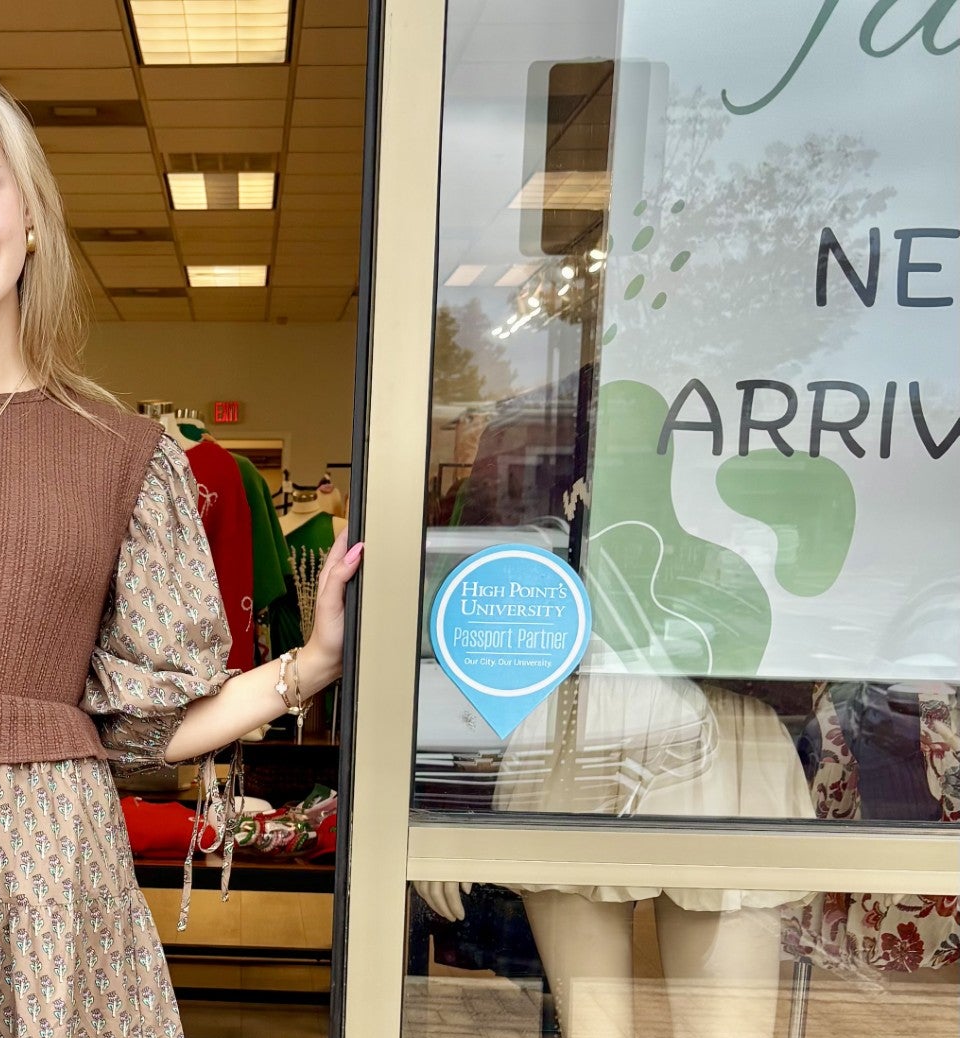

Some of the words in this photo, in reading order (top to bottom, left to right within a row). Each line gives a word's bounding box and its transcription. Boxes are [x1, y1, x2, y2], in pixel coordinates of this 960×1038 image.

[214, 401, 239, 422] EXIT
[656, 378, 960, 459] ARRIV
[461, 581, 505, 598] HIGH
[509, 582, 567, 599] POINT'S
[461, 599, 566, 617] UNIVERSITY
[453, 627, 513, 651] Passport
[517, 629, 569, 650] Partner
[464, 658, 479, 666] Our
[498, 659, 512, 667] Our
